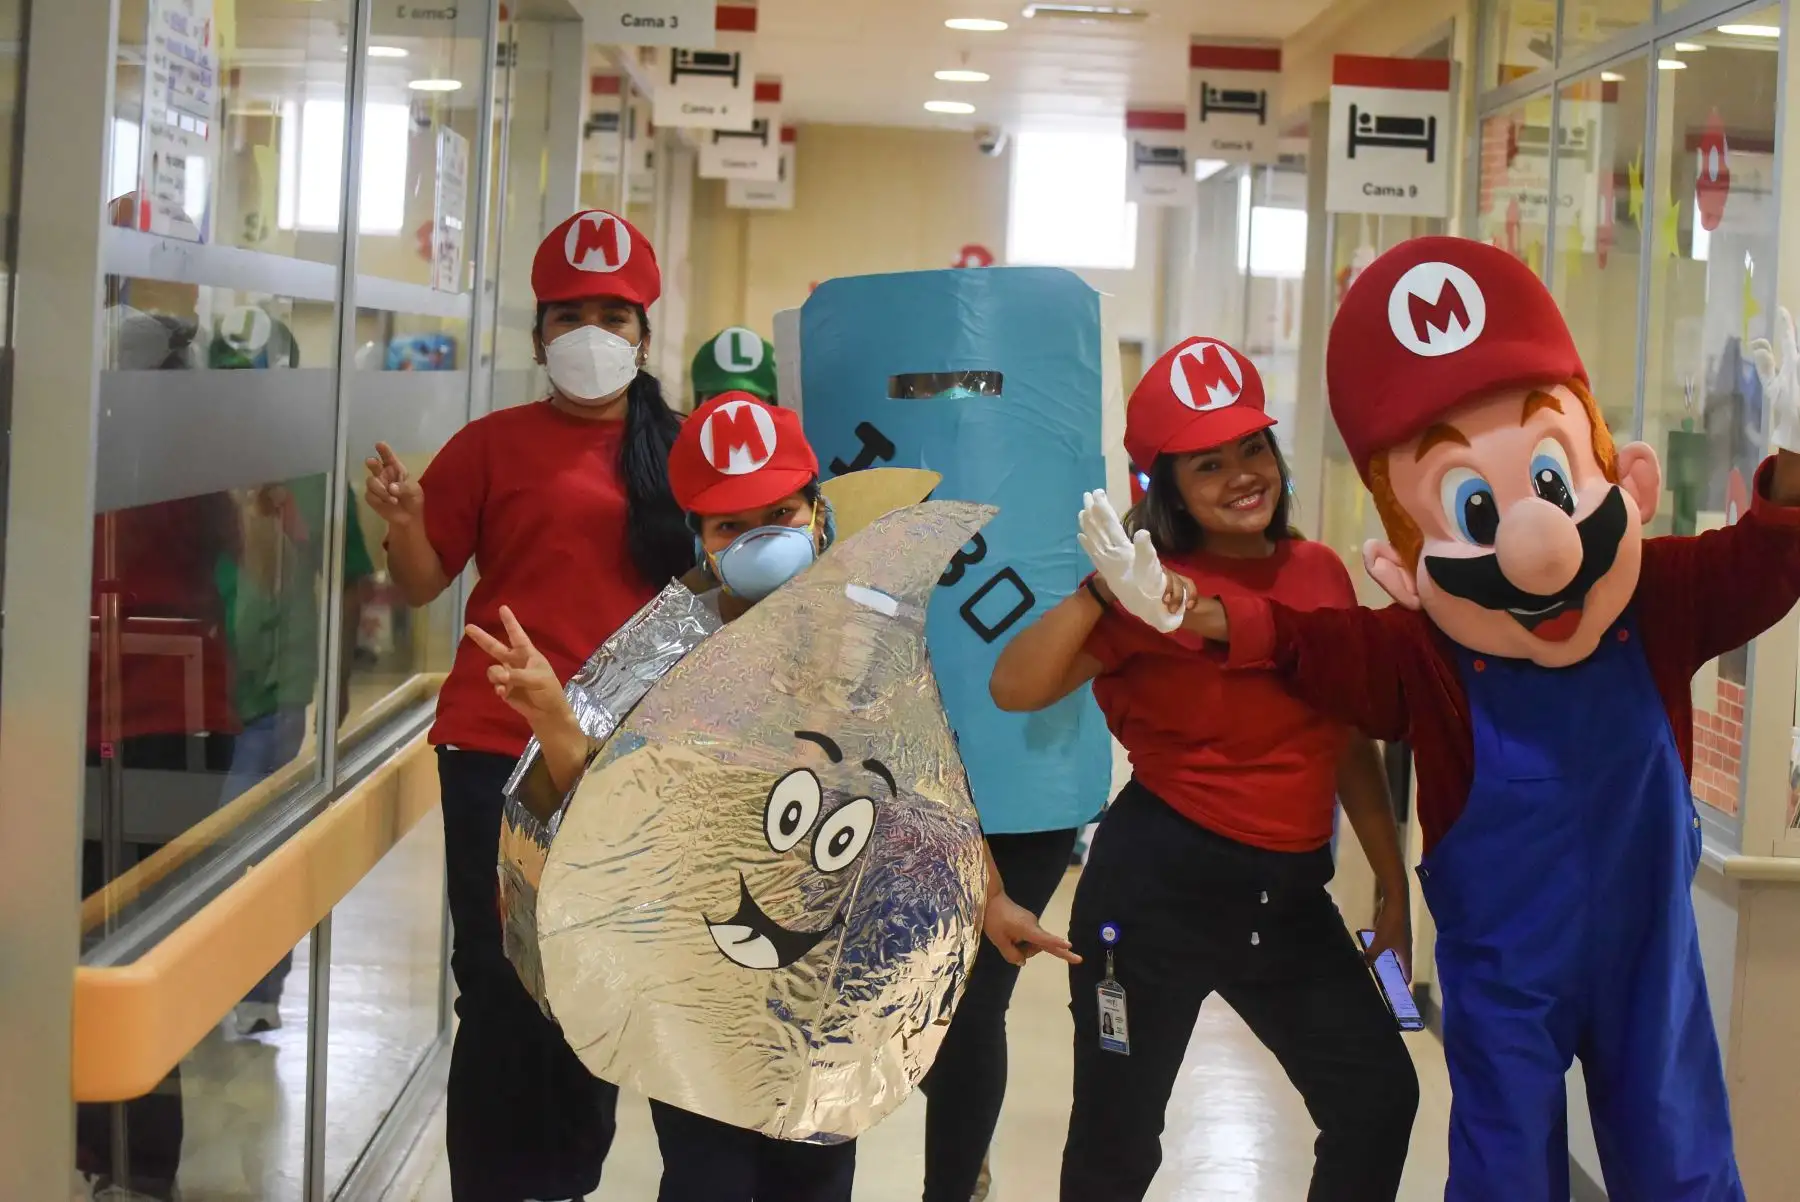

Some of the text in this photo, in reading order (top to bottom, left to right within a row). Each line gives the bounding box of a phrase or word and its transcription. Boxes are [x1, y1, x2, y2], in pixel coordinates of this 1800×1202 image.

[621, 13, 679, 29] Cama 3
[1362, 182, 1418, 198] Cama 9
[572, 218, 620, 267] M
[1408, 277, 1472, 345] M
[730, 332, 753, 366] L
[1179, 343, 1241, 407] M
[712, 404, 769, 469] M
